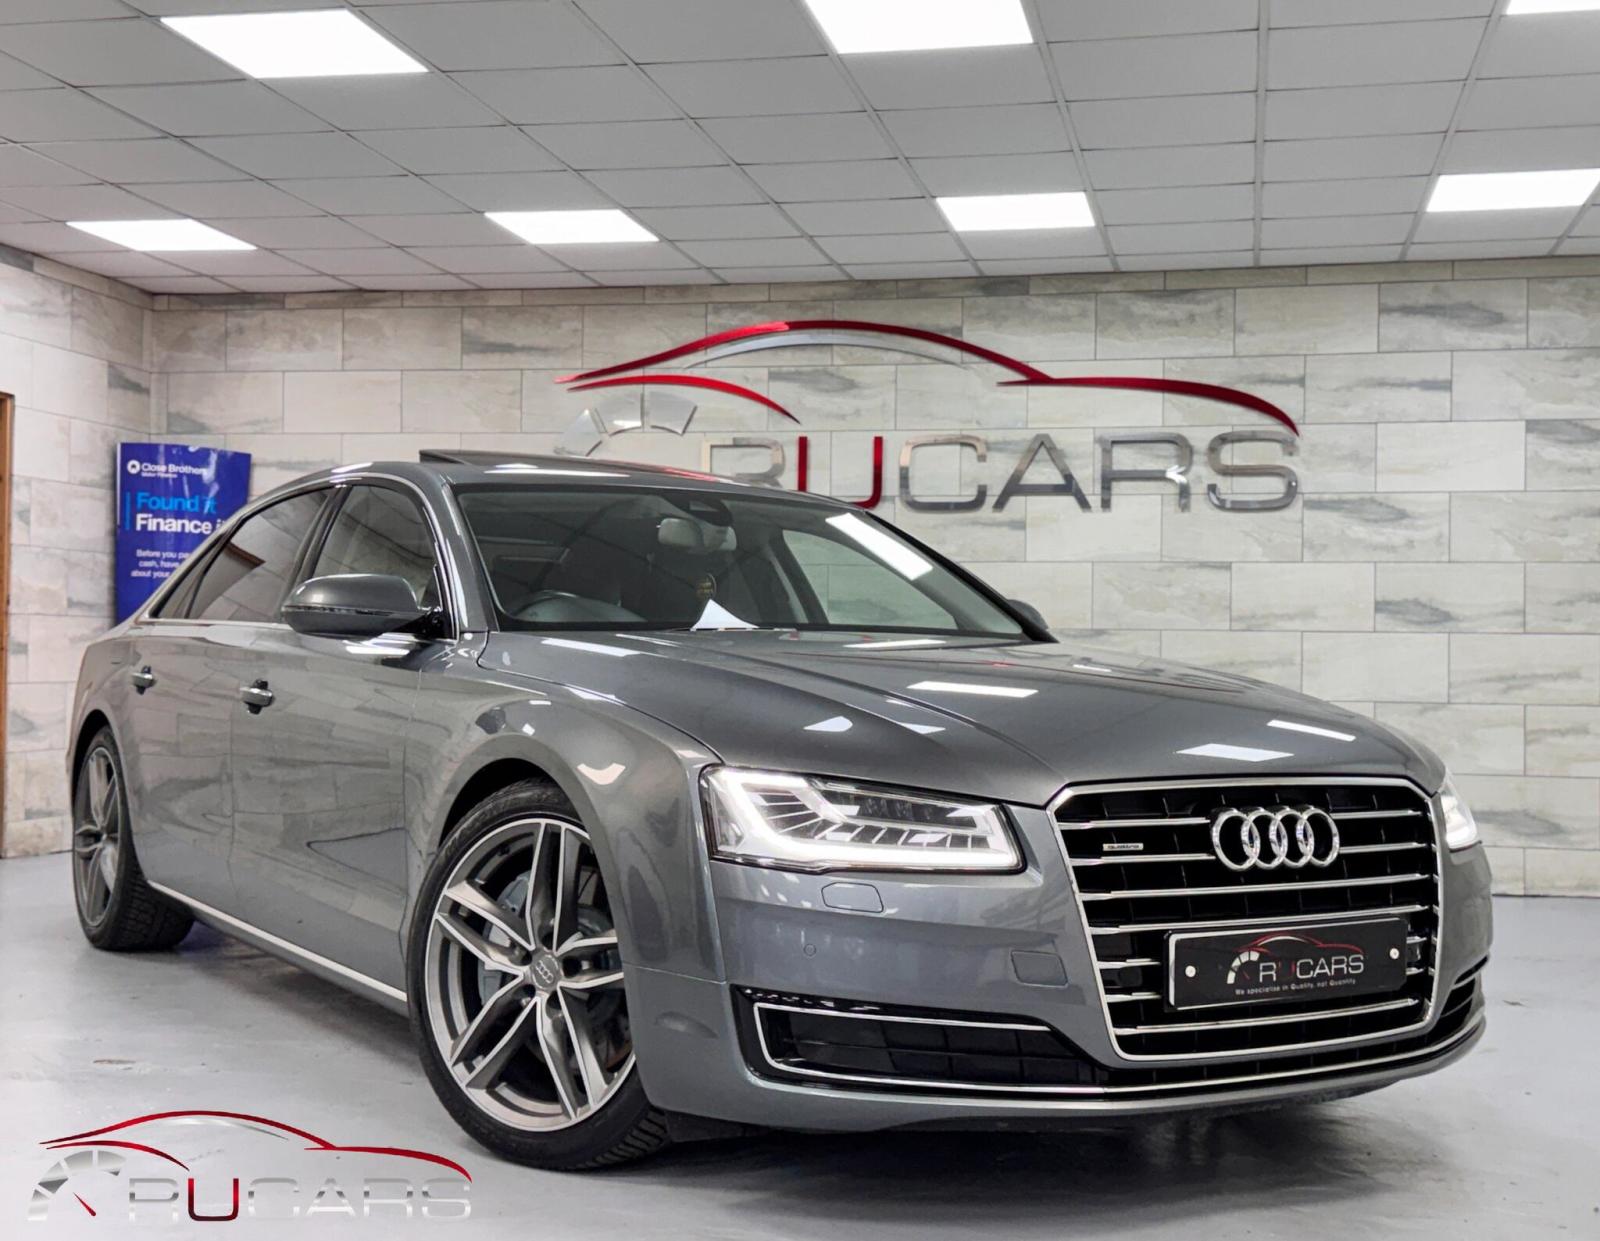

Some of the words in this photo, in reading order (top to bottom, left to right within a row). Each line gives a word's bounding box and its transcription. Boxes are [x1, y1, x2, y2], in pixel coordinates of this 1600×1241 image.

[141, 462, 167, 472] Close
[136, 492, 200, 512] Found
[136, 514, 212, 534] Finance
[136, 549, 160, 558] Before
[162, 551, 177, 559] you
